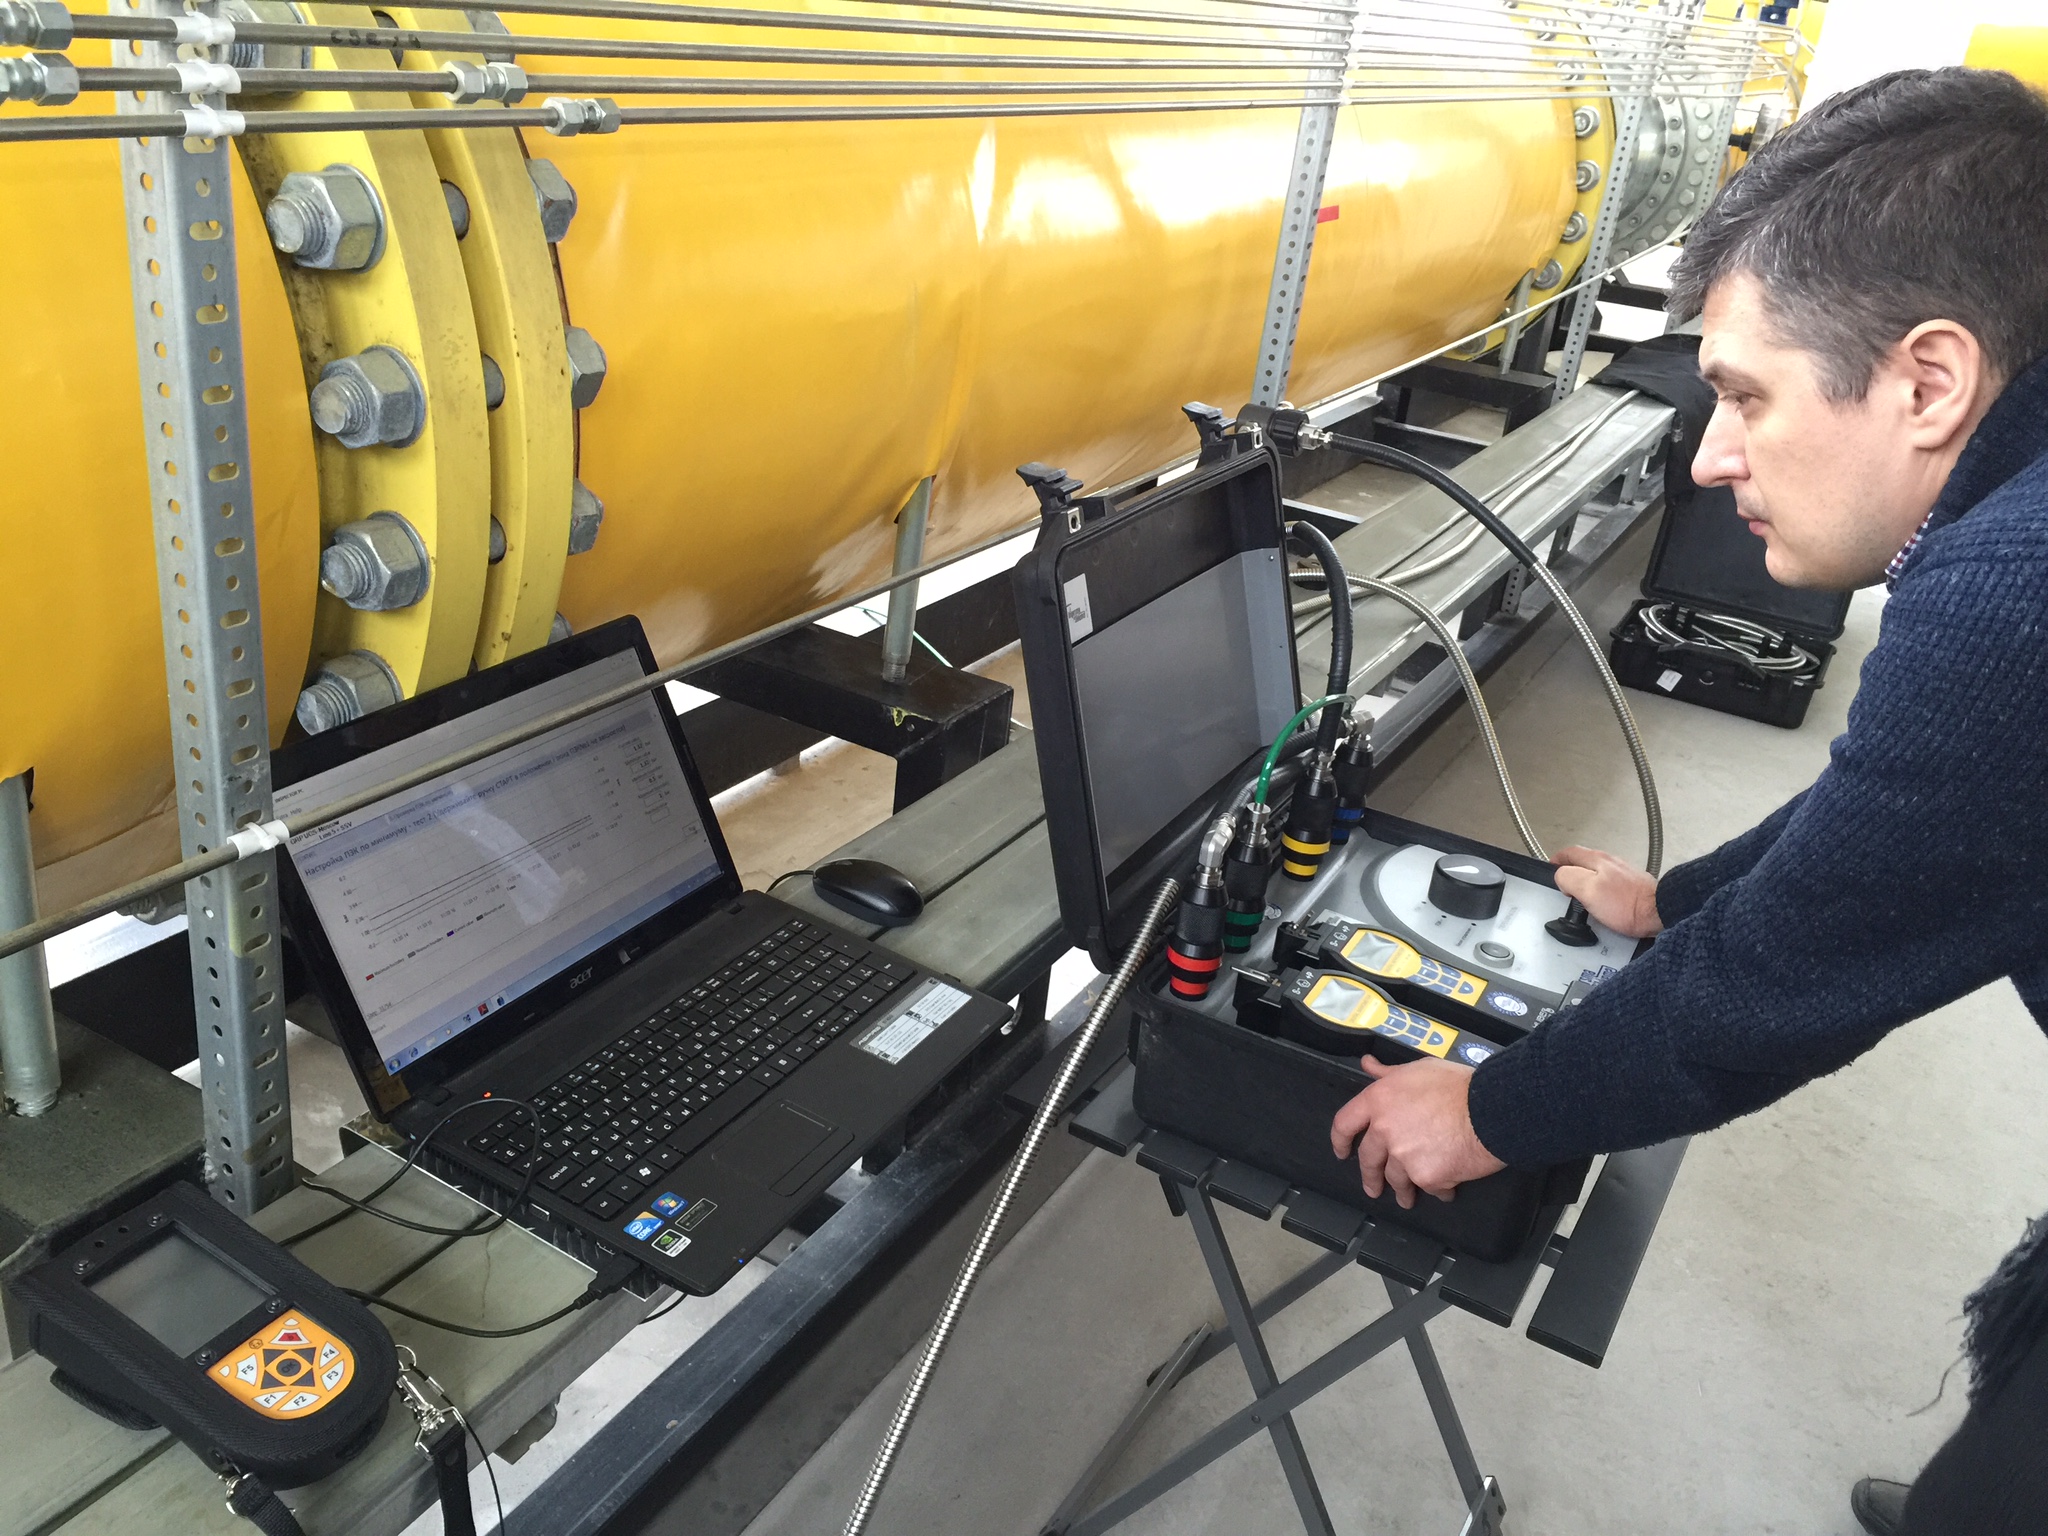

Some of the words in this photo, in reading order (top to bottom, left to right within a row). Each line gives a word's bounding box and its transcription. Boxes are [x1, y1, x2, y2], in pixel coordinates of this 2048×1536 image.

[304, 853, 344, 878] Настройка
[343, 846, 359, 858] ПЗК
[359, 843, 369, 851] по
[370, 825, 408, 848] минимуму
[412, 816, 426, 827] тест
[494, 775, 514, 789] СТАРТ
[570, 966, 593, 989] acer
[557, 1165, 569, 1175] Lock
[549, 1171, 560, 1181] Caps
[637, 1226, 653, 1239] CORE
[323, 1348, 335, 1359] F4
[241, 1364, 254, 1375] F5
[281, 1361, 297, 1374] OK
[326, 1370, 339, 1380] F3
[264, 1394, 276, 1405] F1
[293, 1395, 307, 1406] F2
